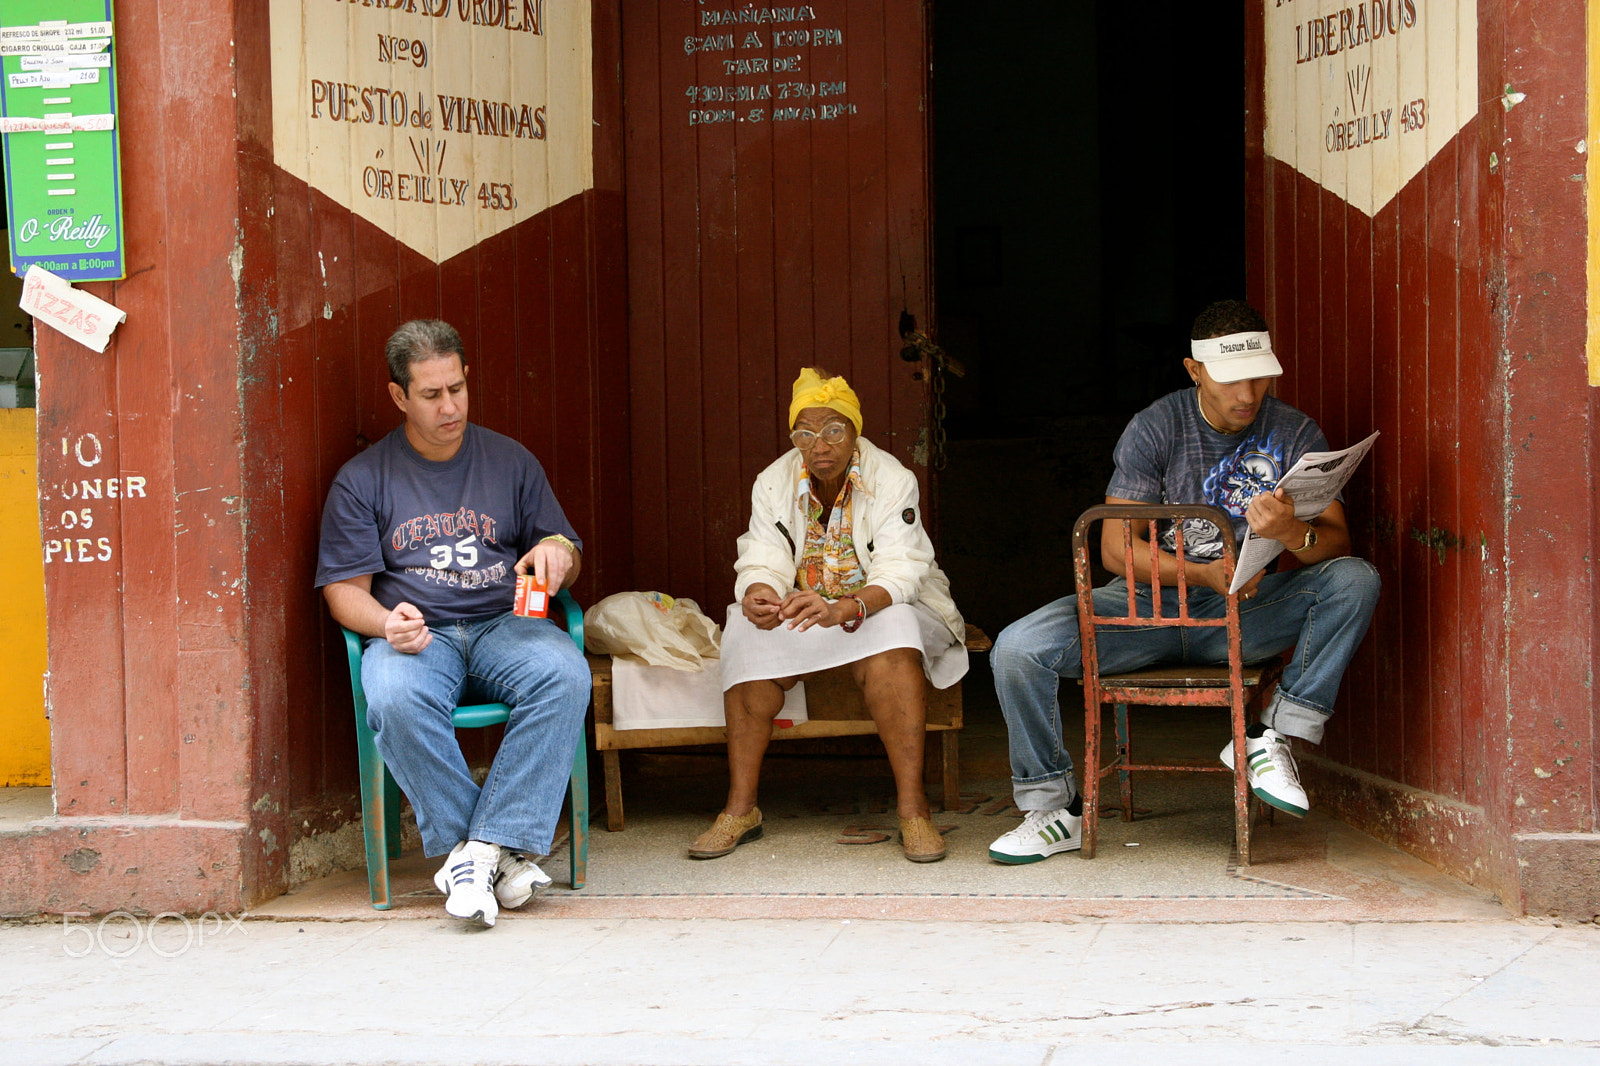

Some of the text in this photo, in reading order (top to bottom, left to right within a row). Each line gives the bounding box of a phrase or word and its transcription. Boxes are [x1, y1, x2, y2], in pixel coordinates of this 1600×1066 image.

[2, 30, 30, 38] REFRESCO
[31, 29, 39, 37] DE
[40, 29, 61, 37] SIROPE
[64, 28, 76, 36] 232
[741, 31, 763, 49] A
[813, 28, 843, 47] PM
[1295, 0, 1417, 64] LIBERADOS
[1, 45, 30, 53] CIGARRO
[32, 43, 64, 52] CRIOLLOS
[311, 79, 547, 141] PUESTO de VIANDAS
[1400, 98, 1429, 134] 453
[477, 182, 517, 211] 453
[71, 262, 77, 270] a
[79, 258, 115, 270] :00pm
[1220, 339, 1262, 353] Treasure Island
[391, 506, 498, 551] CENTRAL
[44, 537, 112, 564] PIES
[430, 534, 479, 570] 35
